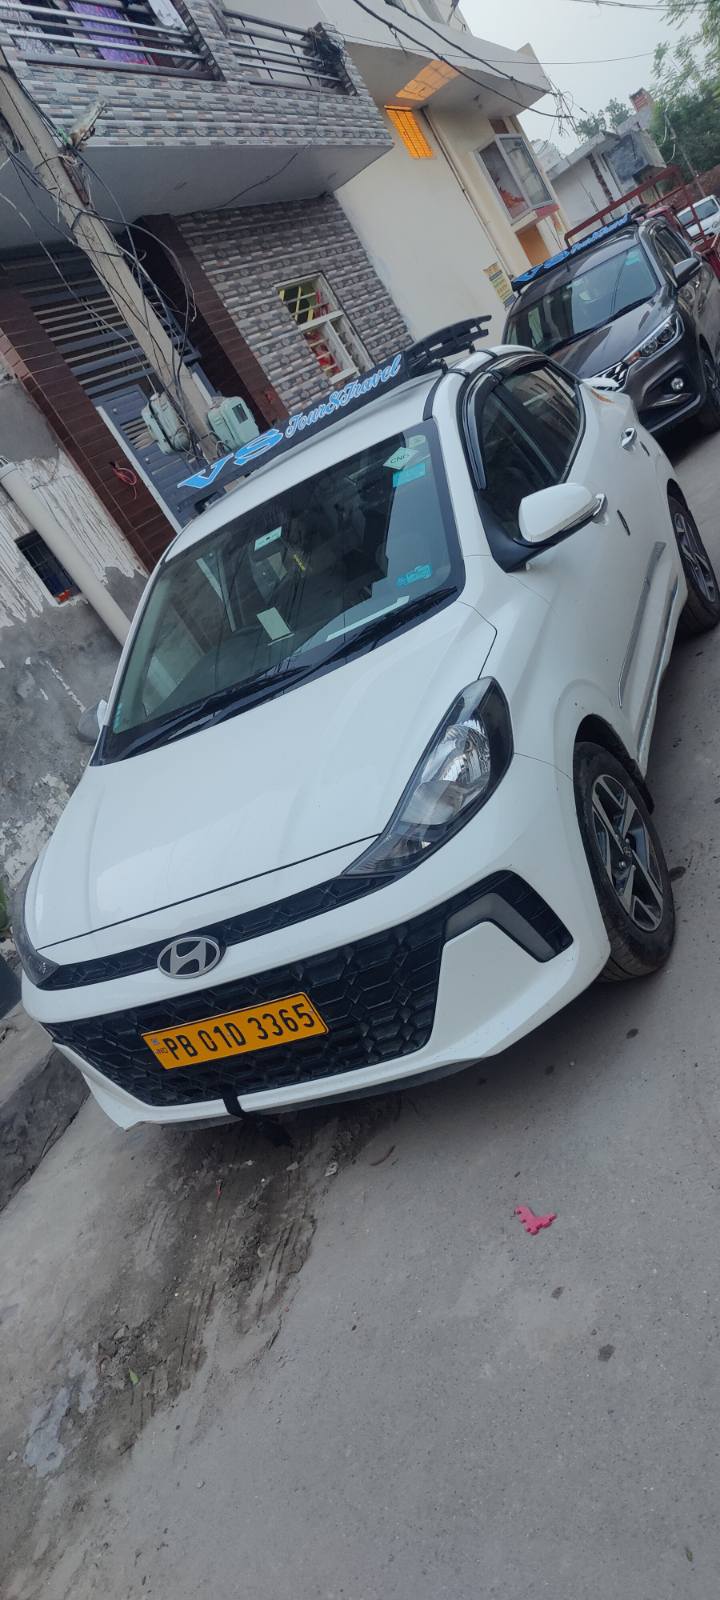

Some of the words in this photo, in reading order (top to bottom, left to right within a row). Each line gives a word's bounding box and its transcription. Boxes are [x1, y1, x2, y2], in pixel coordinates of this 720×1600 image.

[177, 428, 284, 489] VS
[162, 1034, 199, 1060] PB
[197, 1022, 247, 1052] 01D
[247, 1002, 316, 1041] 3365
